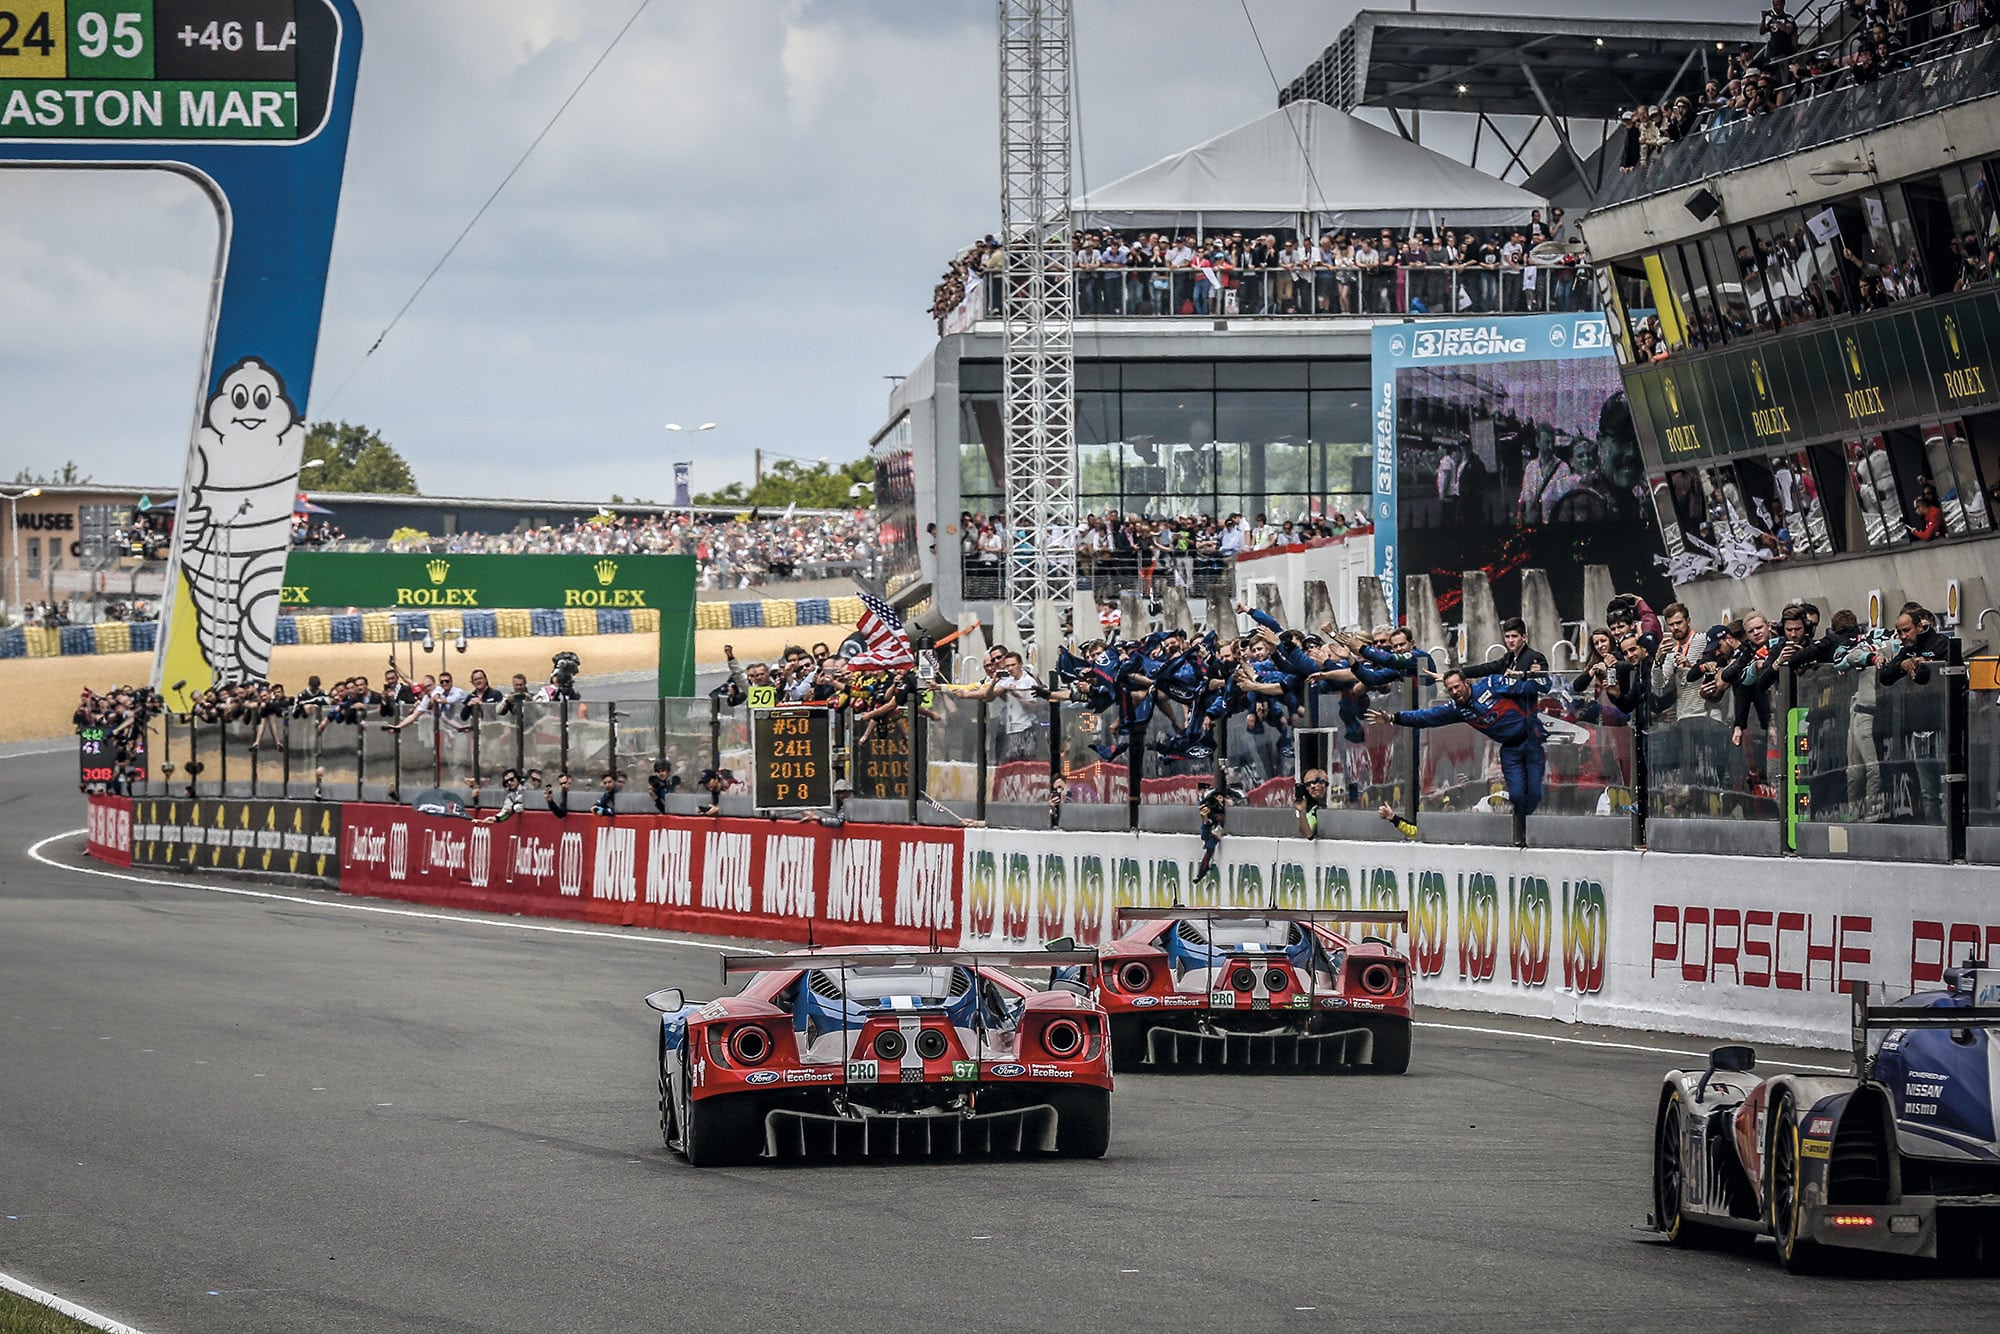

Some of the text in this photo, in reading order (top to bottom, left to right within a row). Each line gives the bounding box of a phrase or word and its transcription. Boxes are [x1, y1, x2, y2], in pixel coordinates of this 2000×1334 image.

[0, 12, 56, 57] 24
[77, 12, 144, 59] 95
[177, 21, 243, 51] +46
[1, 90, 162, 127] ASTON
[1445, 327, 1503, 342] REAL
[1443, 338, 1526, 356] RACING
[1944, 367, 1985, 399] ROLEX
[1845, 386, 1885, 418] ROLEX
[1752, 406, 1791, 436] ROLEX
[1665, 424, 1701, 452] ROLEX
[11, 513, 73, 531] MUSEE
[397, 588, 478, 606] ROLEX
[565, 590, 646, 607] ROLEX
[751, 690, 772, 705] 50
[773, 719, 809, 735] #50
[774, 741, 812, 757] 24H
[770, 762, 816, 779] 2016
[777, 783, 808, 800] P 8
[593, 826, 636, 902] MOTUL
[646, 828, 692, 906] MOTUL
[701, 831, 752, 912] MOTUL
[763, 834, 816, 917] MOTUL
[827, 838, 882, 923] MOTUL
[895, 840, 954, 930] MOTUL
[1508, 874, 1551, 987] VSD
[1562, 878, 1606, 995] VSD
[1651, 905, 1872, 994] PORSCHE
[1211, 993, 1233, 1006] PRO
[751, 1071, 775, 1083] Ford
[787, 1072, 834, 1082] EcoBoost
[848, 1063, 876, 1080] PRO
[955, 1063, 975, 1078] 67
[1032, 1069, 1074, 1078] EcoBoost
[1908, 1071, 1938, 1080] POWERED
[1905, 1083, 1944, 1099] NISSAN
